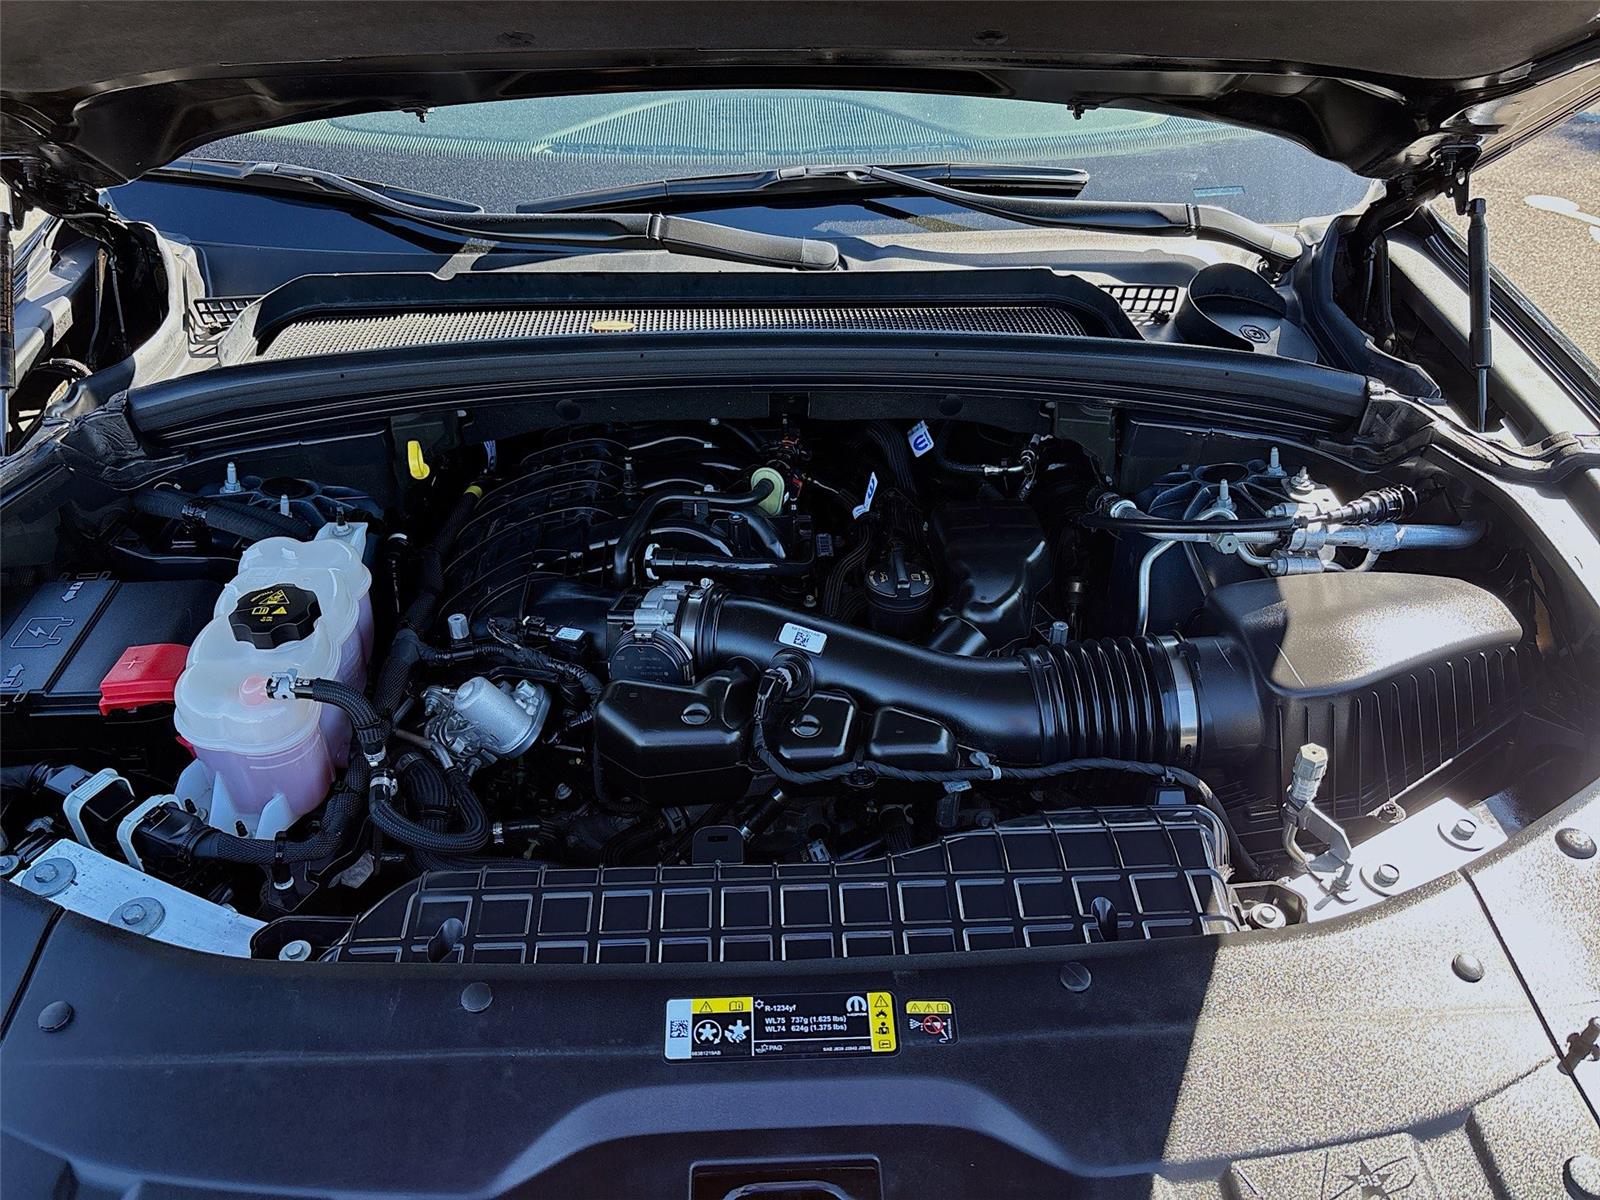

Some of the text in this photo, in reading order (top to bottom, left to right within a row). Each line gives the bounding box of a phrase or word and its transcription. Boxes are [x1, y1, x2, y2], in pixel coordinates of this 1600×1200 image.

[764, 1004, 797, 1013] R-1234yf
[791, 1016, 809, 1025] 737g
[832, 1015, 847, 1023] lbs)
[764, 1023, 847, 1033] WL74 624g (1.375 lbs)
